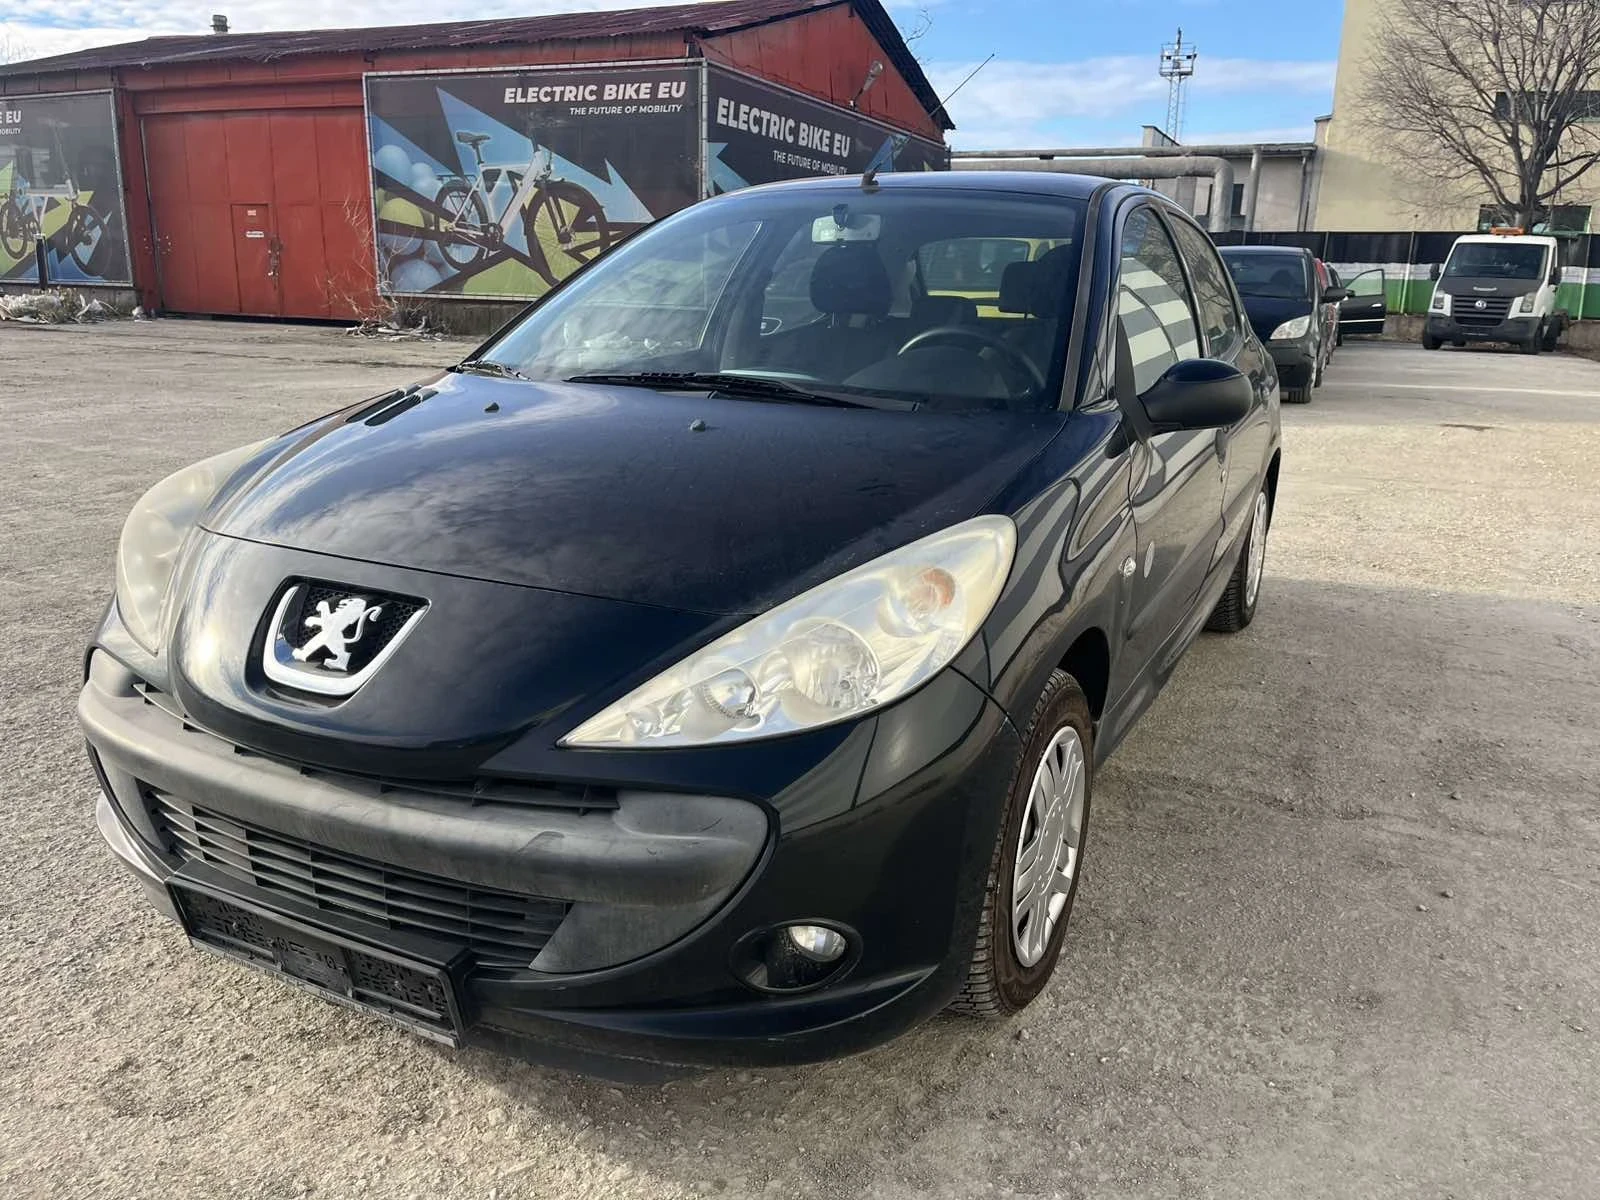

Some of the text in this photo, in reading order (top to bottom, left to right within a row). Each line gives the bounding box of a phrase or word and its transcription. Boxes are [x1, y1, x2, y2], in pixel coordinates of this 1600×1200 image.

[504, 81, 686, 104] ELECTRIC BIKE EU
[6, 110, 21, 123] EU
[569, 104, 683, 116] THE FUTURE OF MOBILITY
[716, 97, 850, 158] ELECTRIC BIKE EU
[773, 150, 847, 175] THE FUTURE OF MOBILITY
